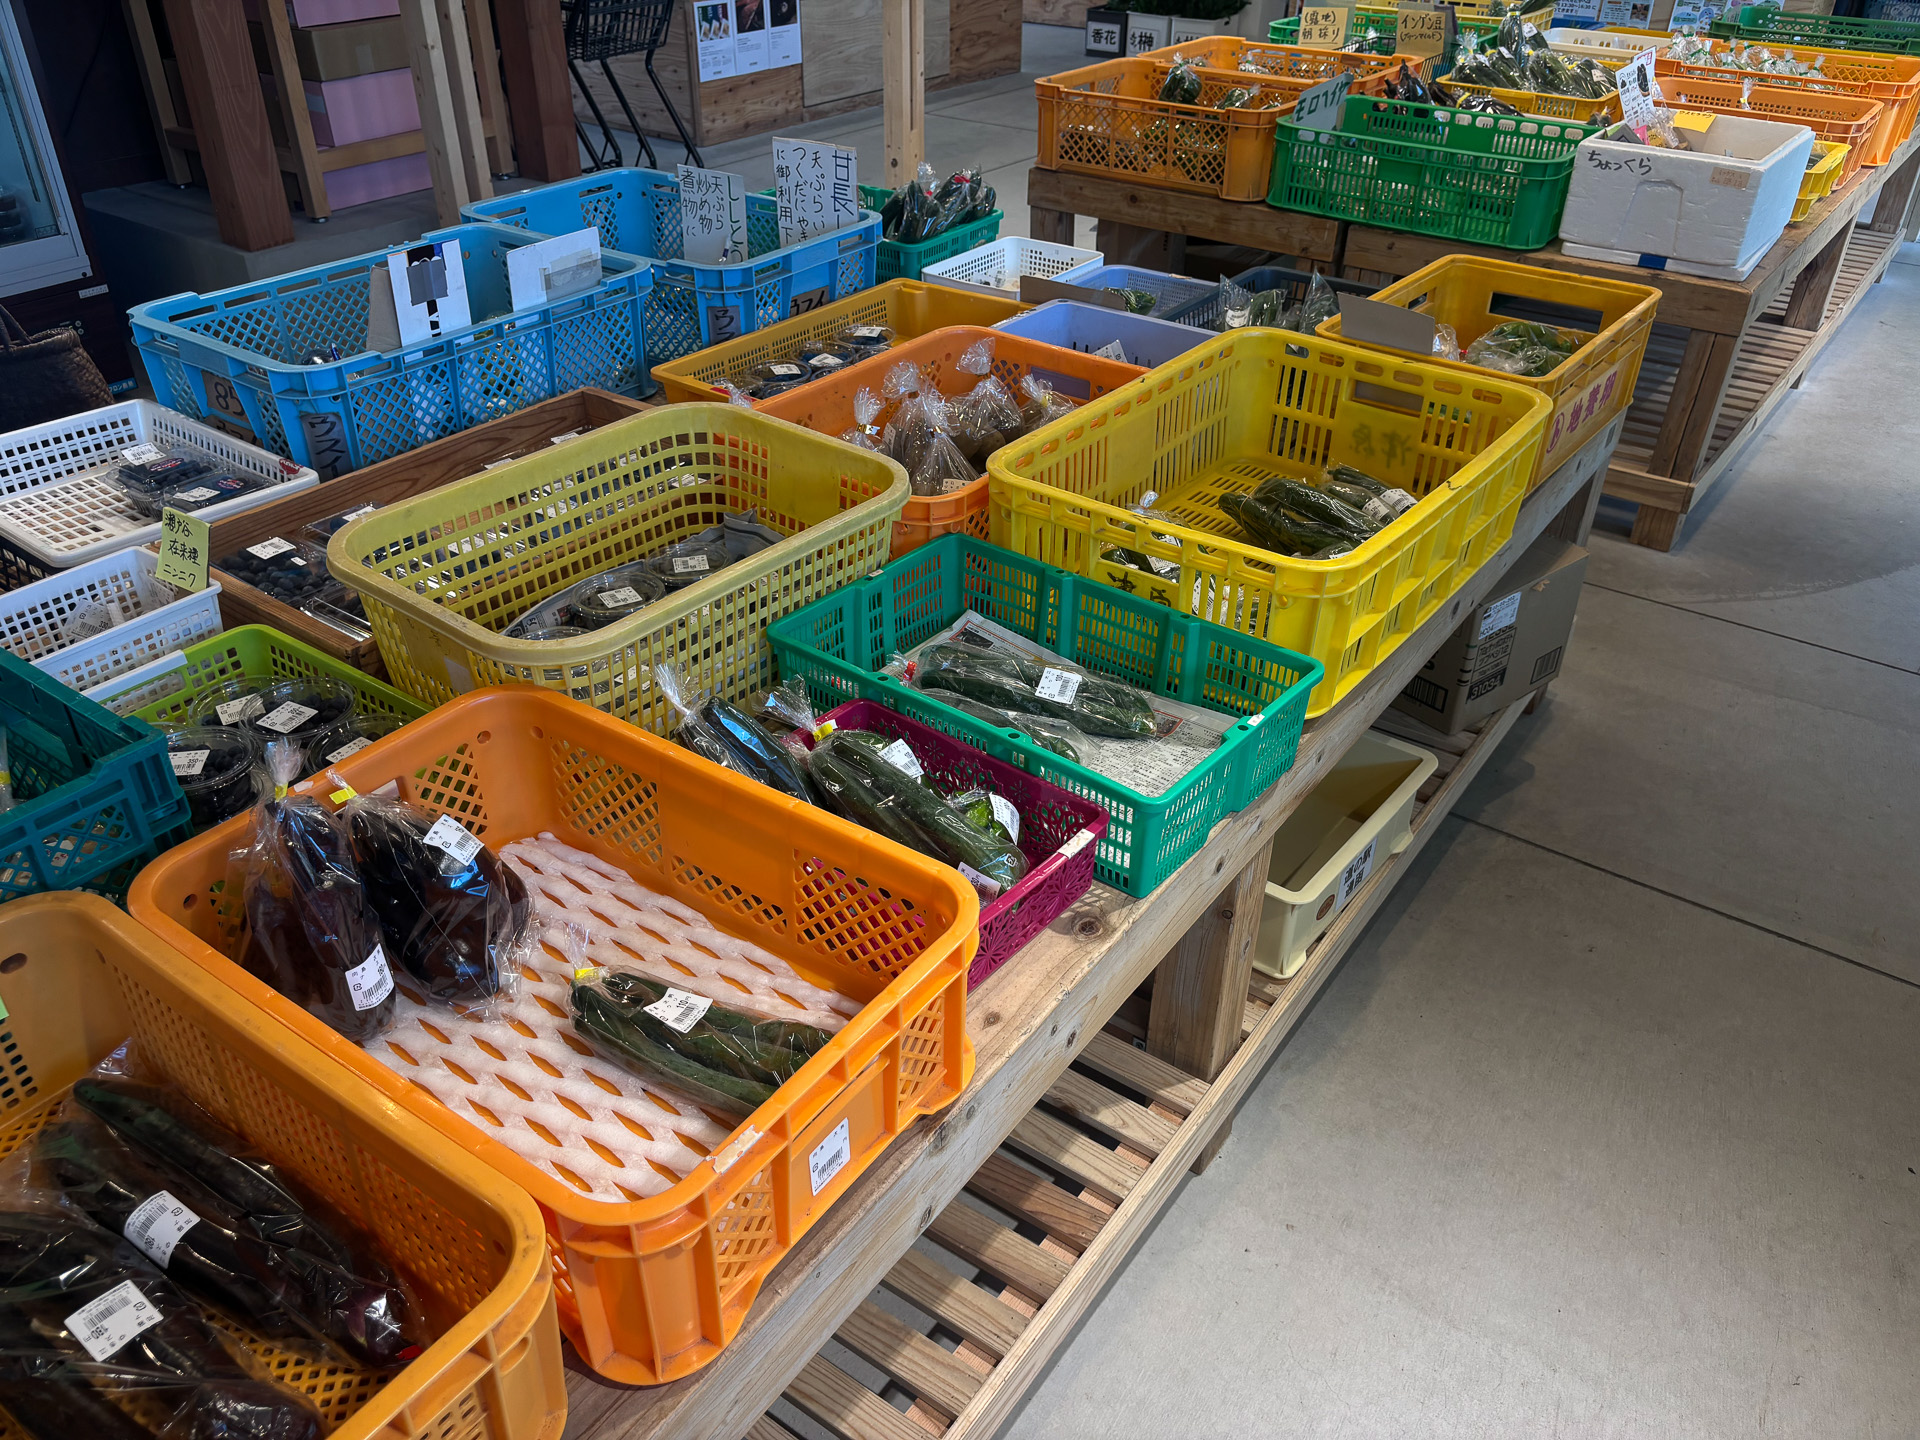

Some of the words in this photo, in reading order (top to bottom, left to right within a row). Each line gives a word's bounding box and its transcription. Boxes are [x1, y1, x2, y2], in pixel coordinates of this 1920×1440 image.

[1091, 28, 1117, 46] 香花
[1401, 13, 1444, 31] インゲン豆
[1294, 80, 1351, 122] モロヘイヤ
[1587, 150, 1653, 176] ちょっくら
[679, 168, 699, 237] 煮物に
[695, 172, 713, 236] 炒め物
[710, 175, 726, 231] 天ぷら
[831, 149, 855, 230] 甘長
[726, 174, 745, 263] ししとう
[167, 538, 201, 567] 在来種
[163, 563, 197, 588] ニンニク
